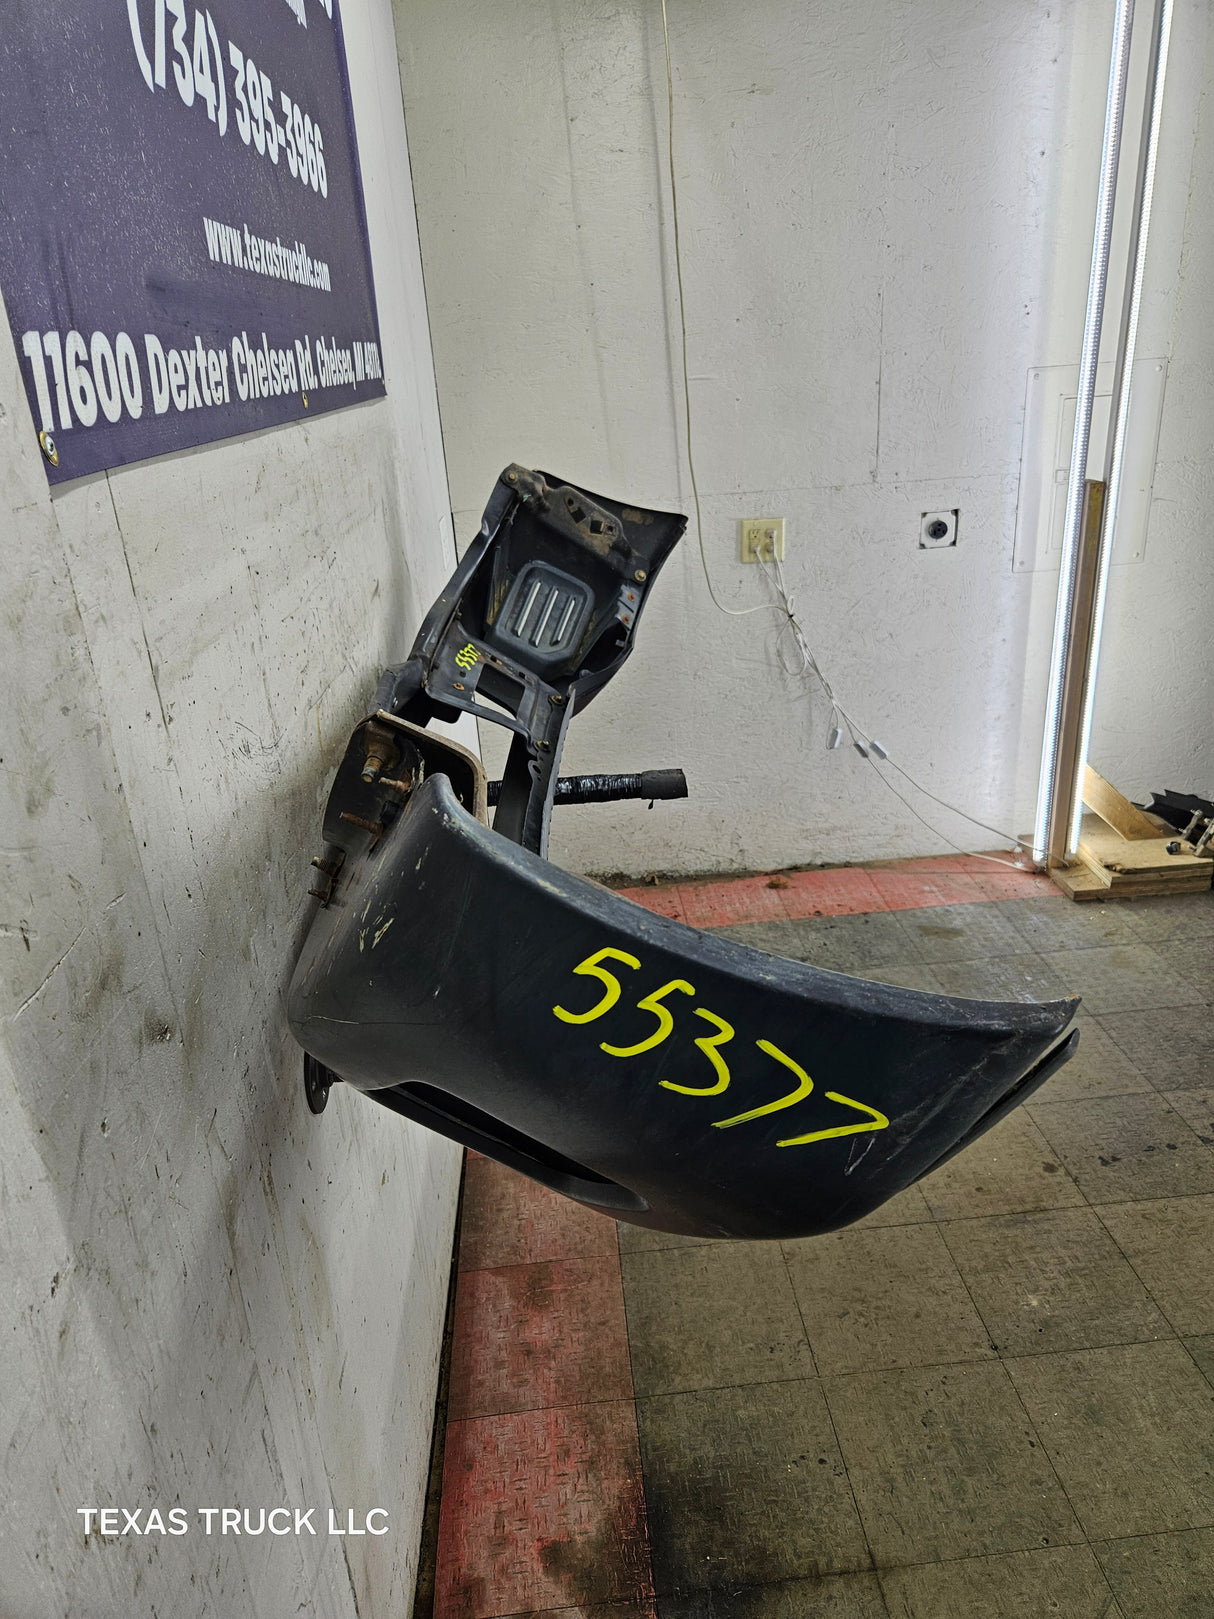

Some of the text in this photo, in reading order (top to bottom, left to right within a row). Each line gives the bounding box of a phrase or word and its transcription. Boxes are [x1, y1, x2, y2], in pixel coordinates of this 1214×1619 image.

[228, 40, 328, 199] 395-3966
[203, 216, 331, 292] www.texastruckllc.com
[22, 330, 143, 432] 11600
[144, 333, 230, 415] Dexter
[232, 331, 299, 401] Chelsea
[295, 334, 319, 391] Rd.
[316, 335, 356, 391] Chelsea,
[455, 643, 481, 670] 55377
[553, 947, 889, 1147] 55377
